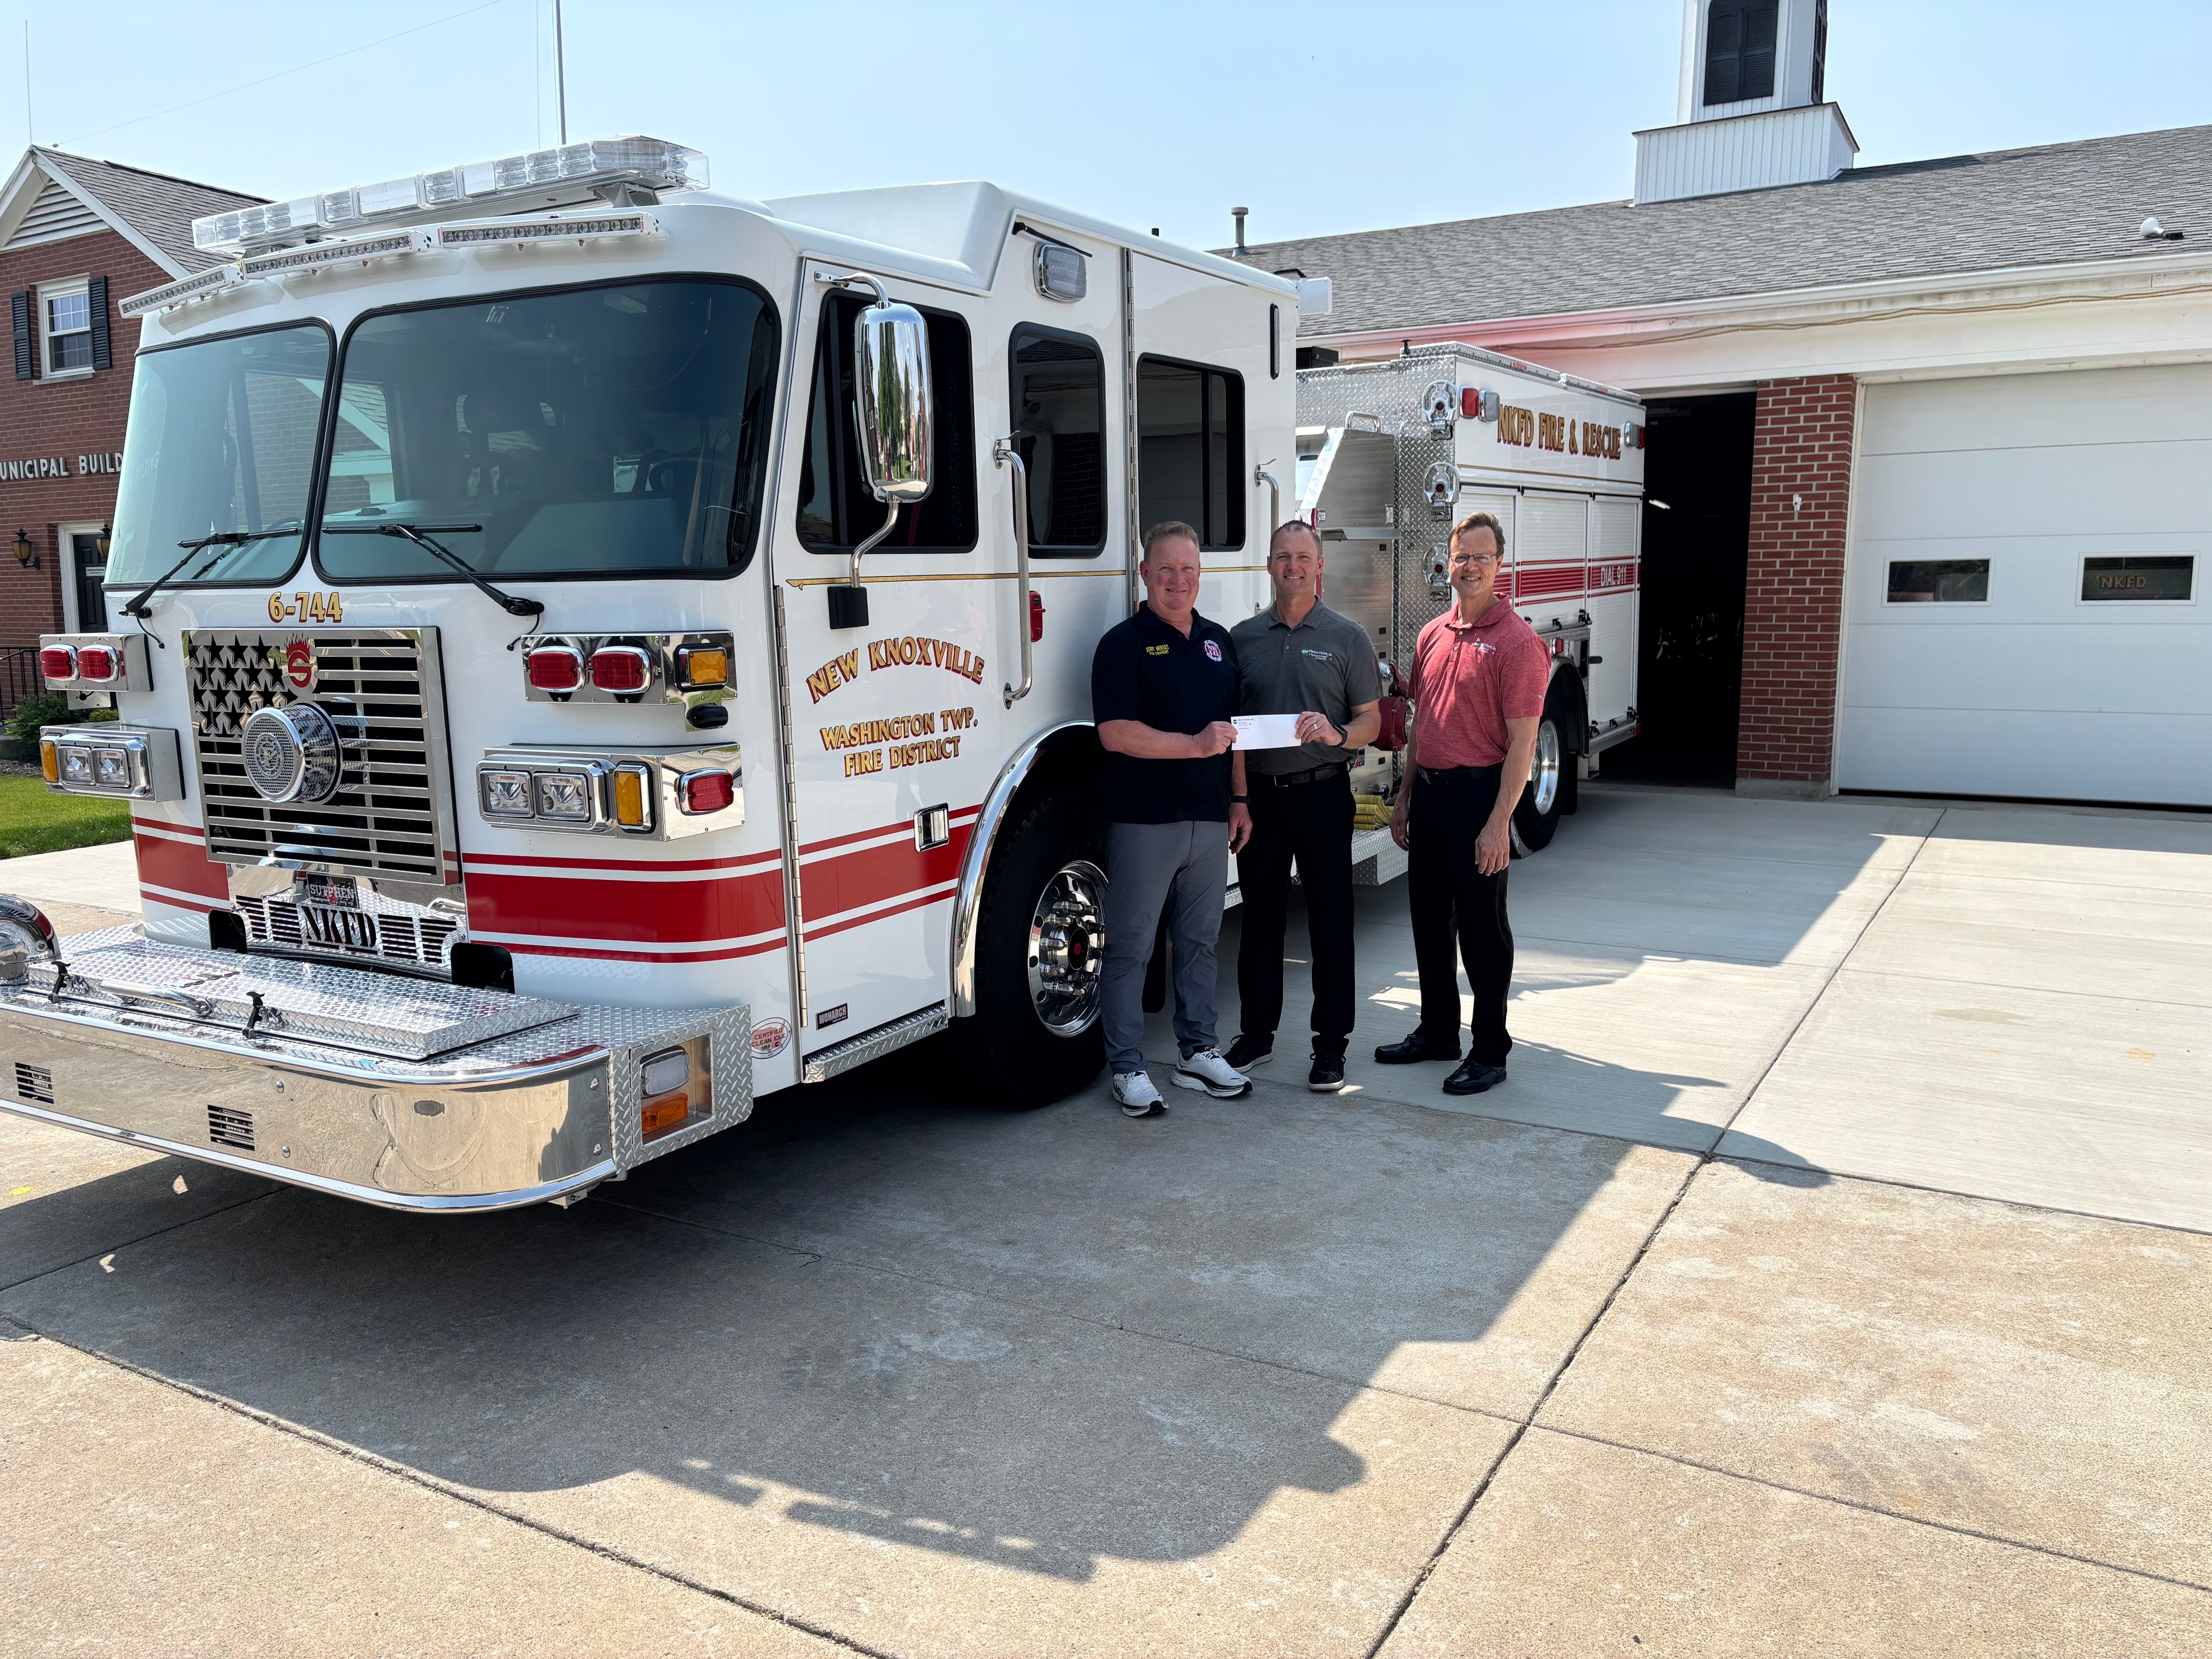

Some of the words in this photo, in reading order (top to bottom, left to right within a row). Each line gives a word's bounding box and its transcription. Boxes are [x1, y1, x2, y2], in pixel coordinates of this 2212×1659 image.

[1497, 404, 1534, 448] NKFD
[1538, 412, 1565, 452] FIRE
[1568, 418, 1578, 455] &
[1582, 422, 1621, 461] RESCUE
[79, 452, 123, 474] BUILD
[1601, 566, 1616, 587] DIAL
[1617, 565, 1627, 584] 911
[2100, 575, 2147, 589] NKFD
[268, 591, 343, 623] 6-744
[806, 648, 859, 705] NEW
[868, 636, 985, 685] KNOXVILLE
[820, 712, 935, 751] WASHINGTON
[940, 707, 978, 733] TWP.
[845, 749, 883, 778] FIRE
[890, 735, 961, 769] DISTRICT
[310, 884, 355, 900] SUTPHEN
[301, 905, 377, 948] NKFD
[819, 1005, 847, 1025] MONARCH
[751, 1037, 772, 1047] CLEAN
[774, 1033, 786, 1041] IDLE
[754, 1027, 783, 1040] CERTIFIED
